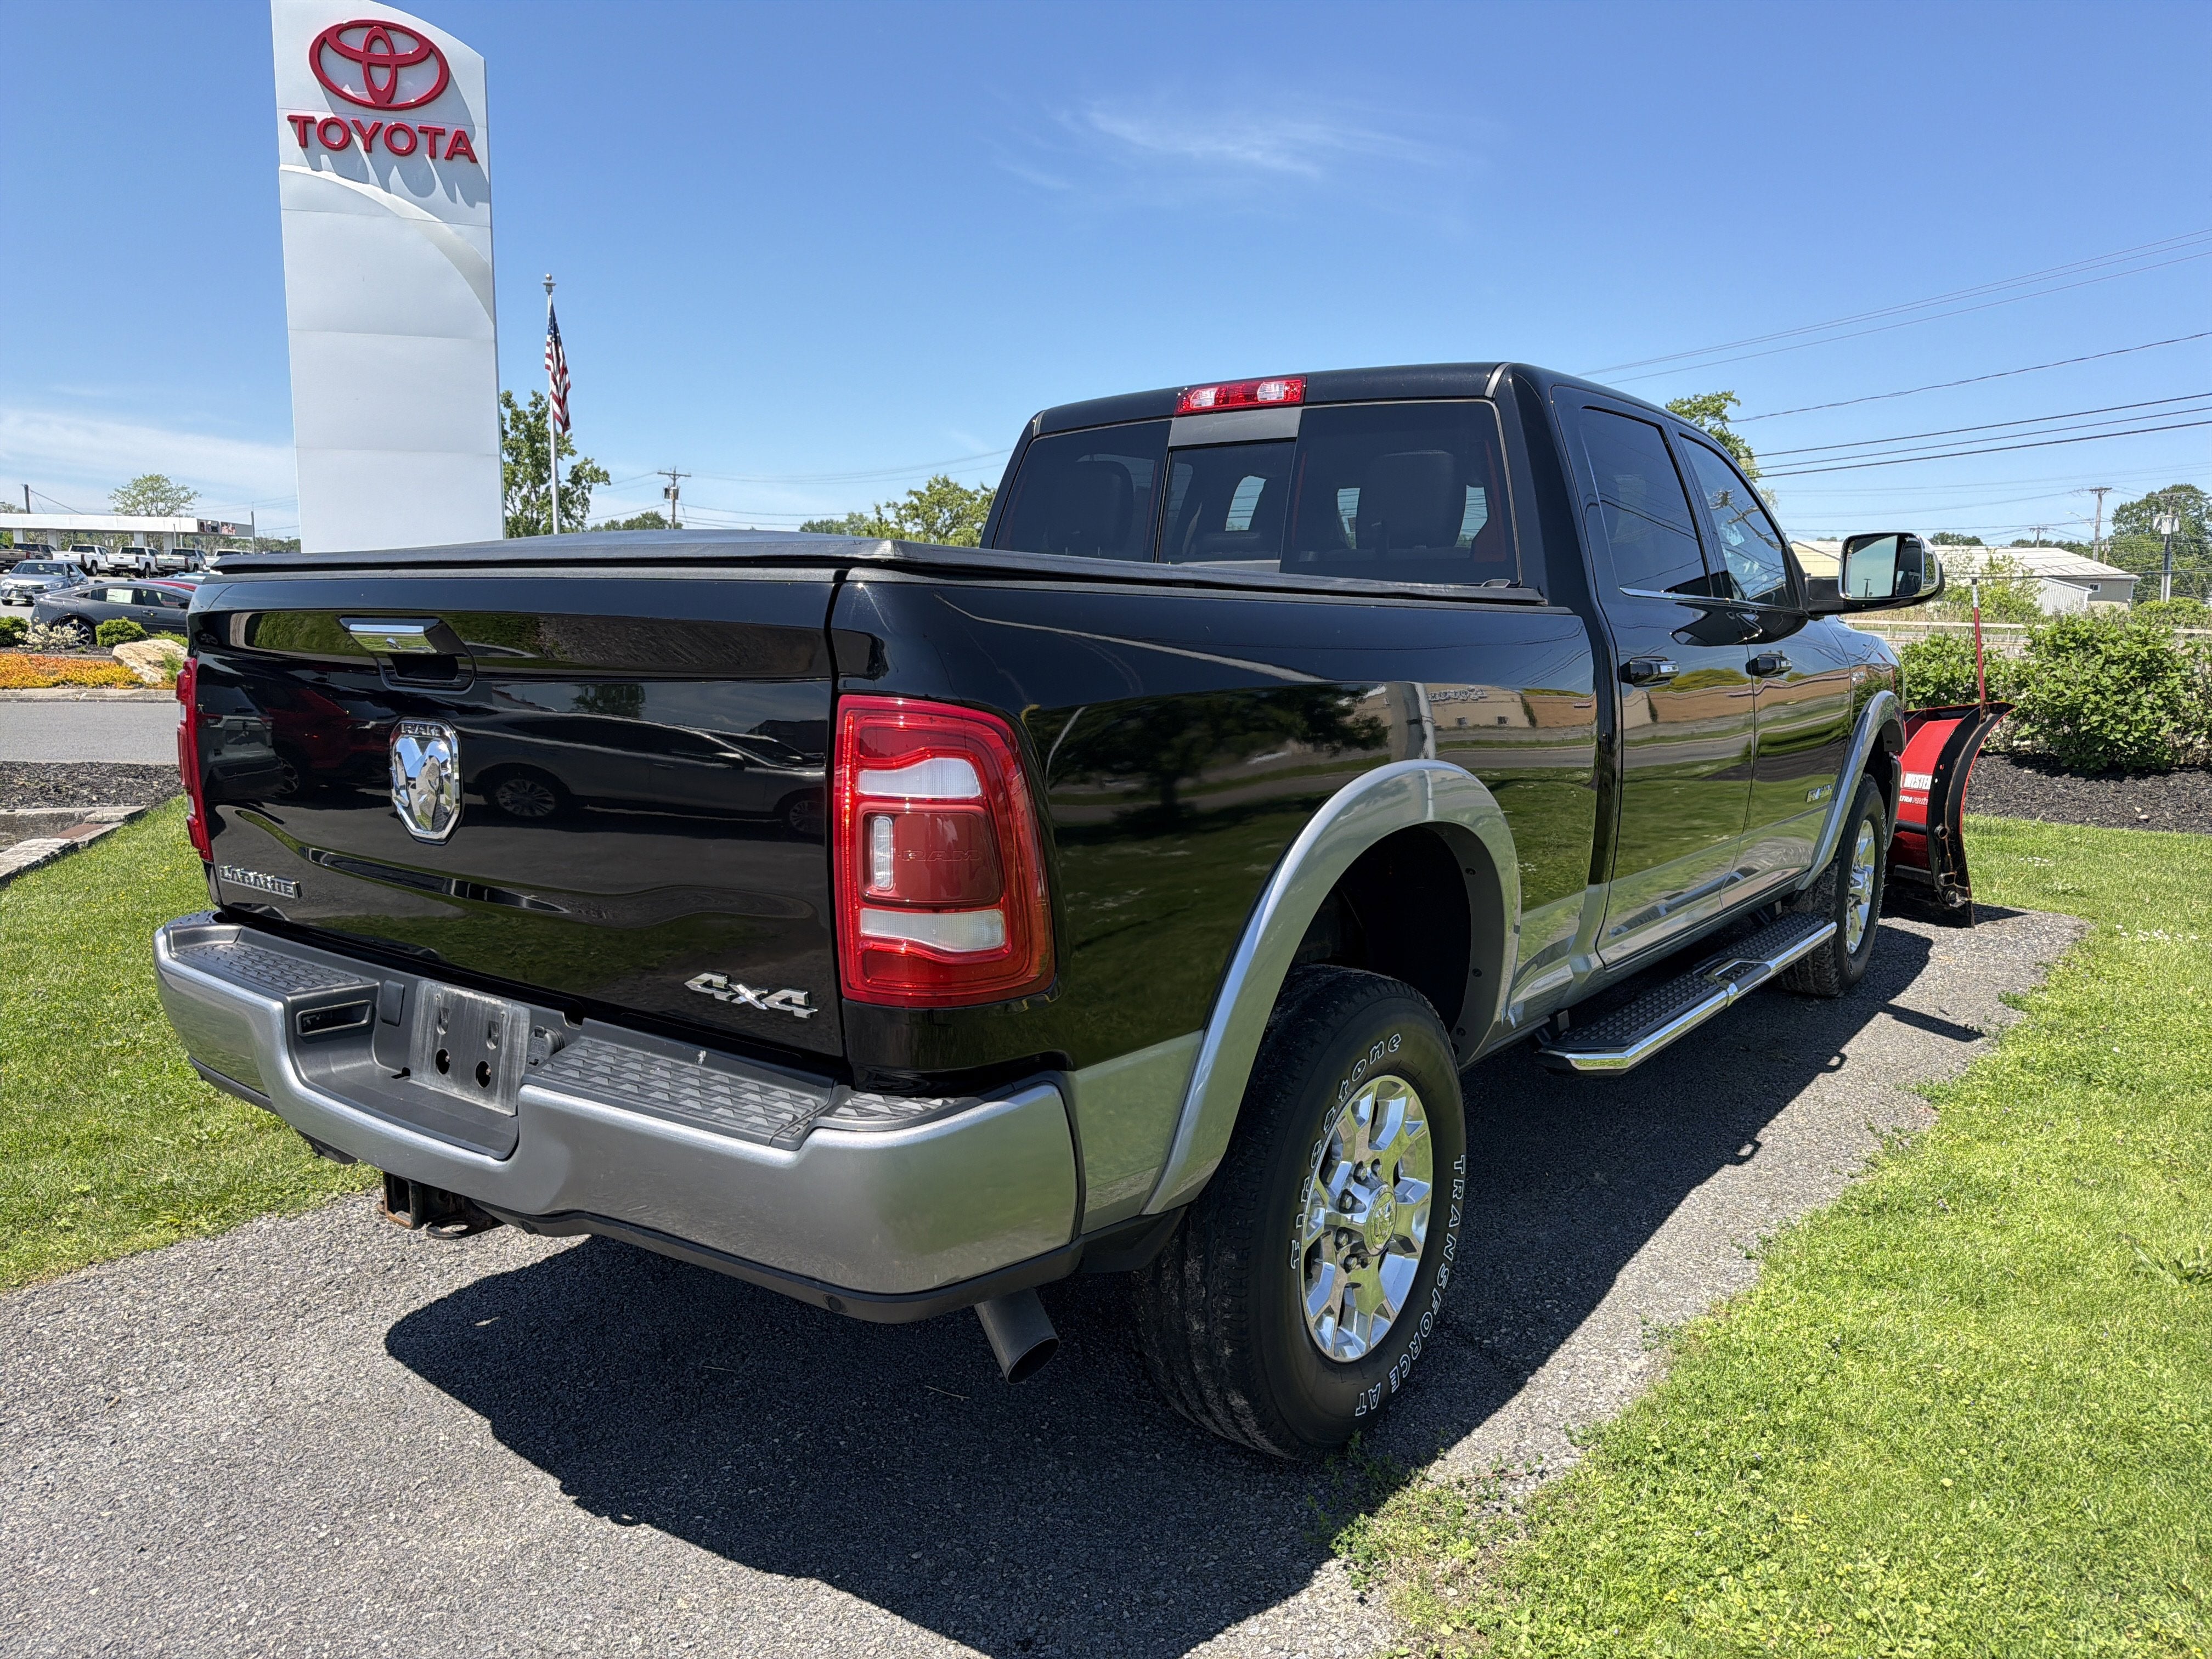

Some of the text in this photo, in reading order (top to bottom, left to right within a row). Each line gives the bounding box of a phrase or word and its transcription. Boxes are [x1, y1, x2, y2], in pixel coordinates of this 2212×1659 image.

[287, 114, 478, 163] TOYOTA
[401, 723, 440, 736] RAM
[902, 850, 979, 862] RAM
[219, 865, 302, 900] LARAMIE
[1355, 1154, 1465, 1417] TRANSFORCE AT
